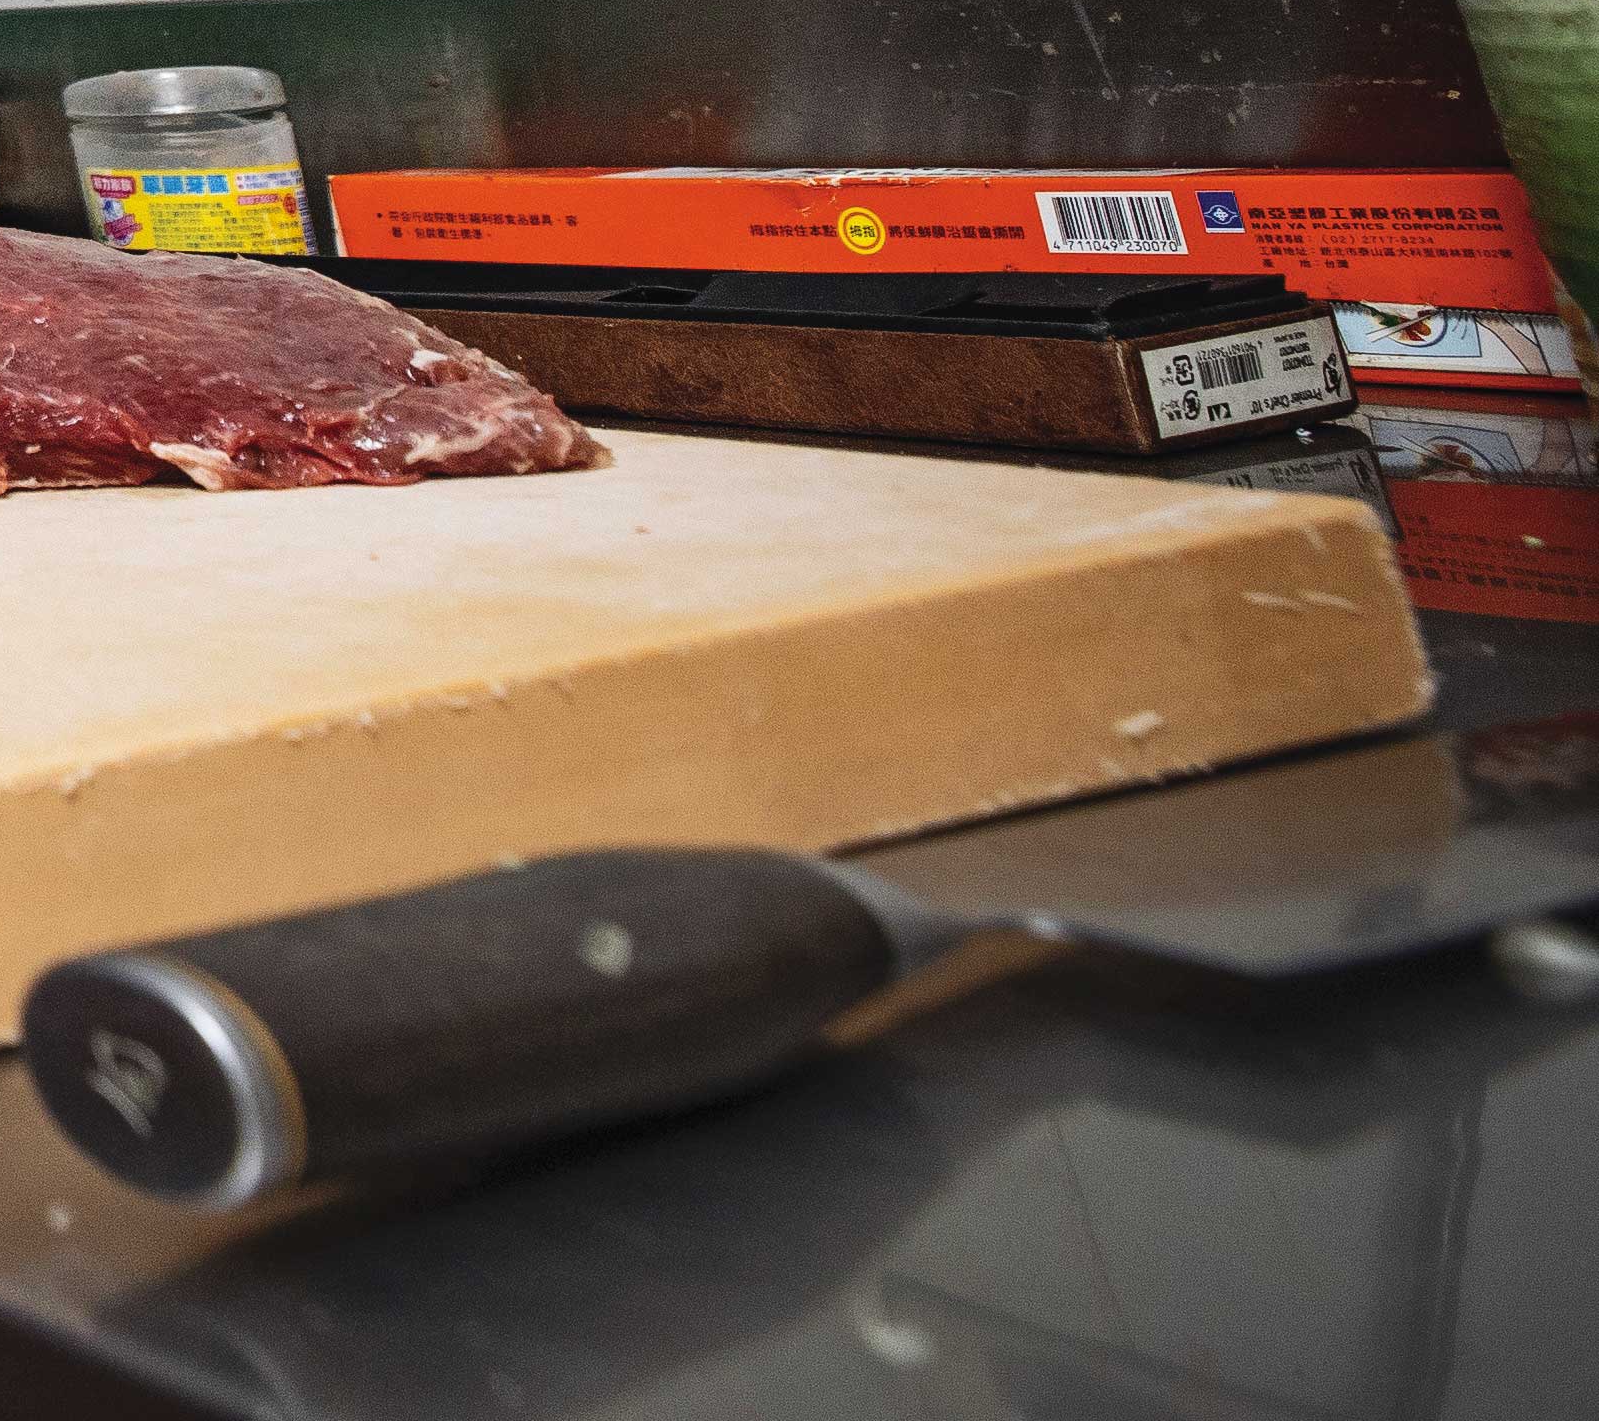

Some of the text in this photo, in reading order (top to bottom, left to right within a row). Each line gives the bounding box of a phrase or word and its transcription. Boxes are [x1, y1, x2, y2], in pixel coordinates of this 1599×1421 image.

[1248, 207, 1501, 220] 南亞塑膠工業股份有限公司
[1251, 222, 1506, 232] NAN YA PLASTICS CORPORATION
[1053, 241, 1179, 253] 4 711049 230070
